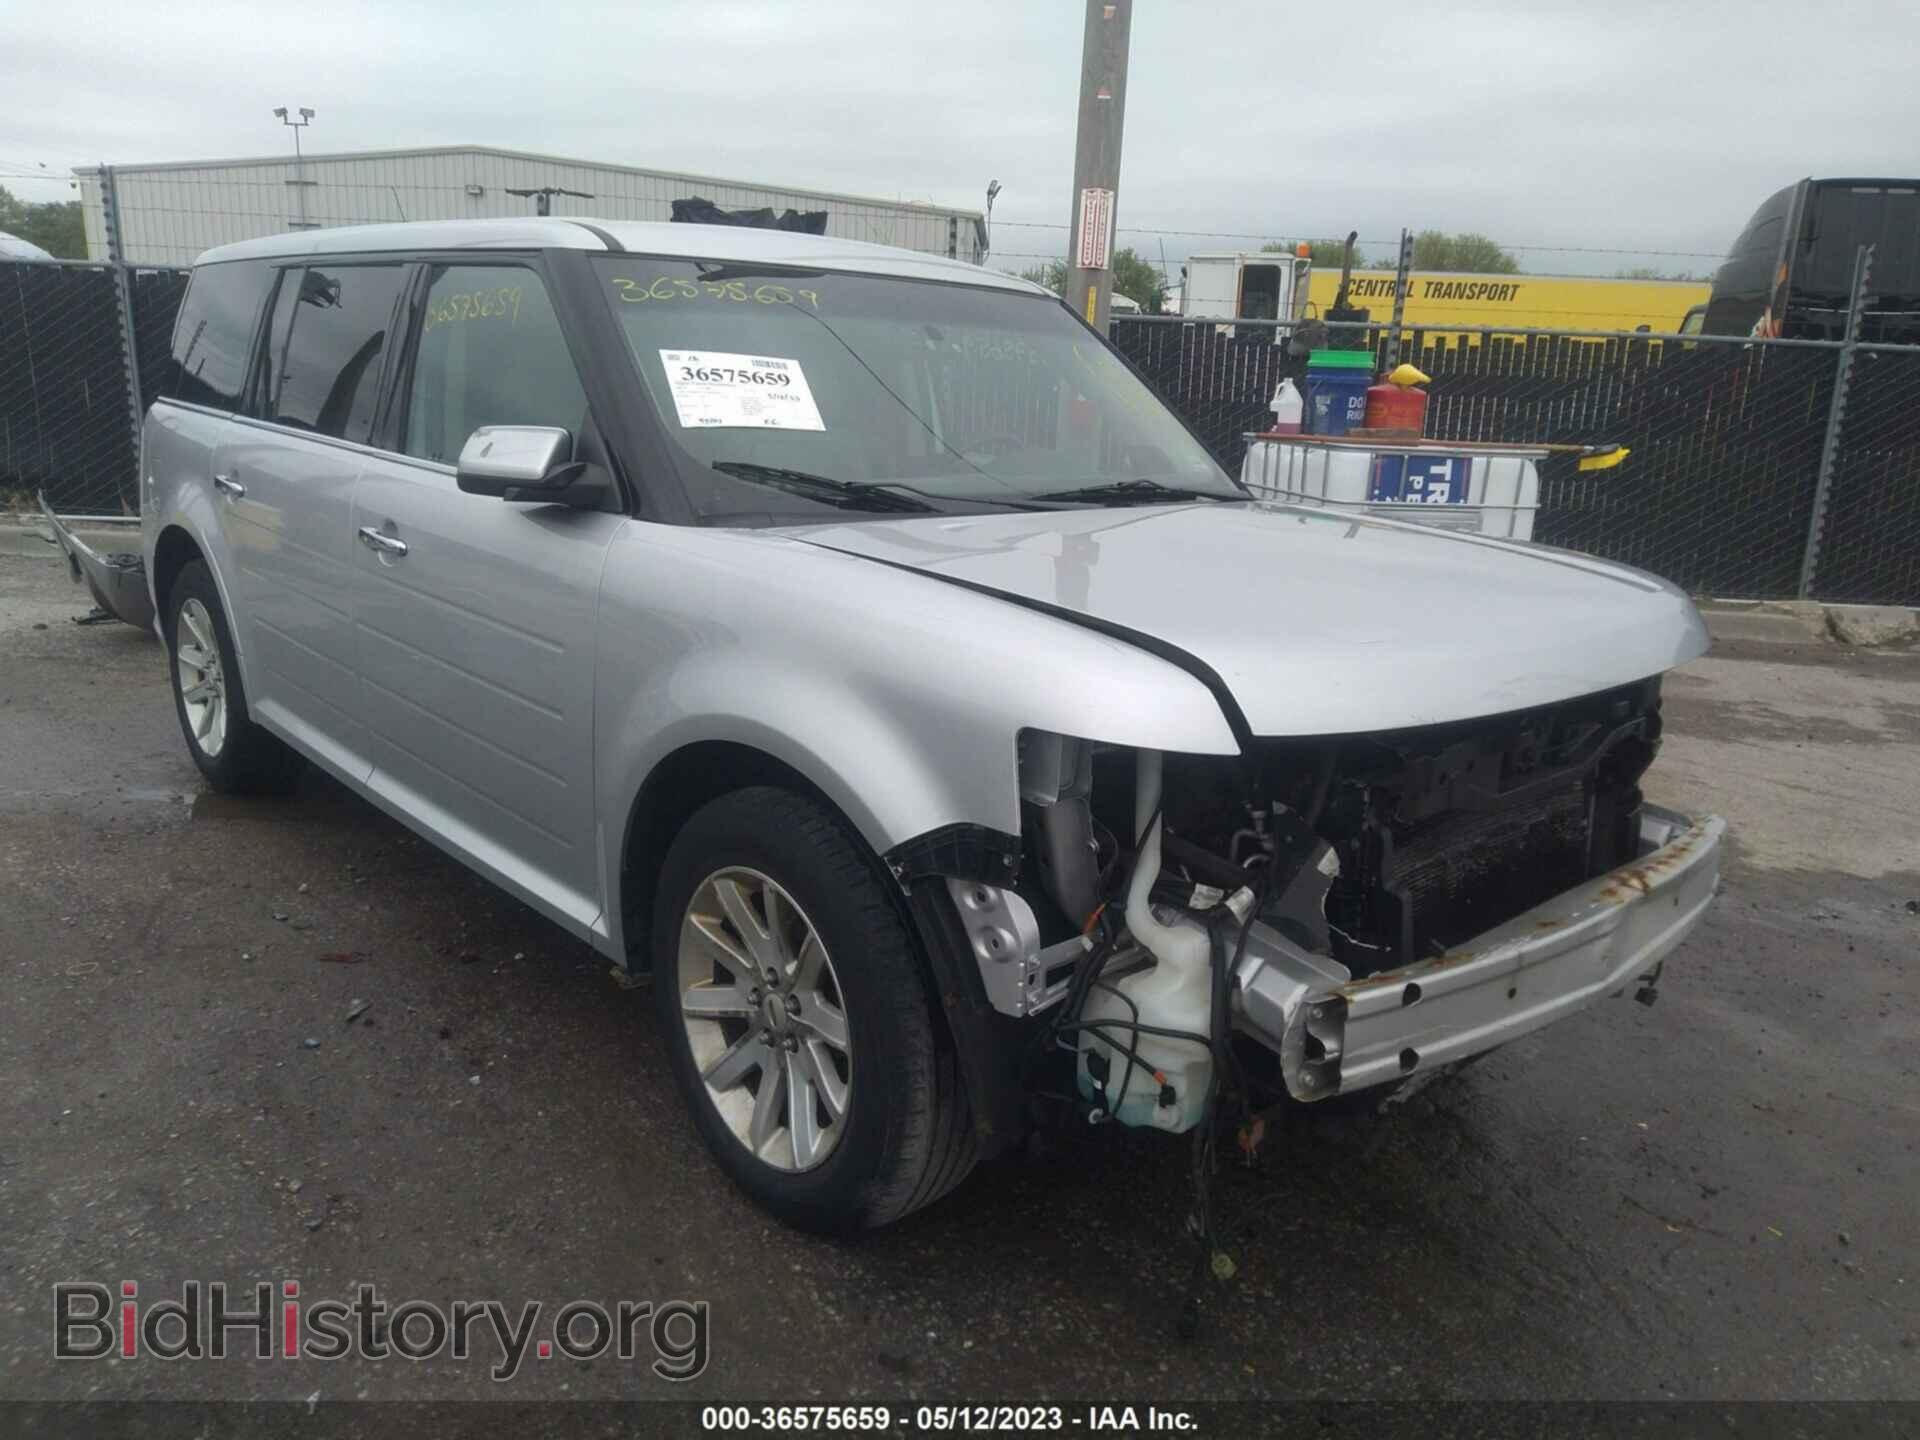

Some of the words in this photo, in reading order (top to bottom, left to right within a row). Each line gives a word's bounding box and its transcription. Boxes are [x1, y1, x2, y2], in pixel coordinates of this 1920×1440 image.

[1348, 279, 1414, 298] CENTRL
[1424, 281, 1520, 302] TRANSPORT
[681, 366, 791, 387] 36575659
